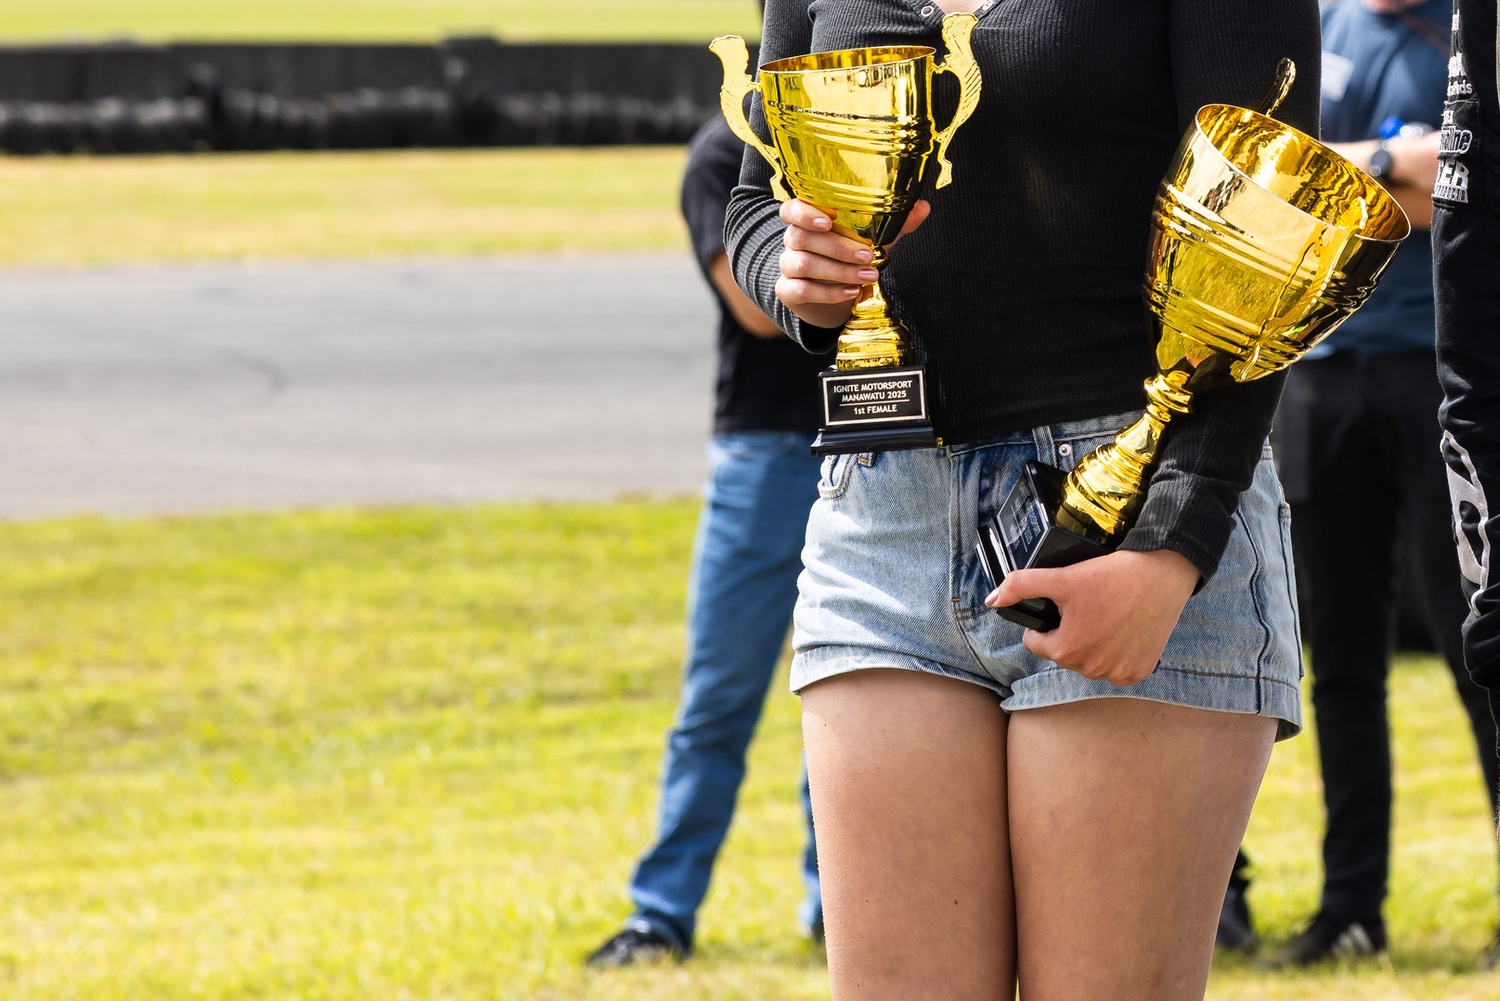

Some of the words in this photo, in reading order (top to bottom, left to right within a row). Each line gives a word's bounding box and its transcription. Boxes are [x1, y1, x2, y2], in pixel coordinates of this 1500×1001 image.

[833, 384, 860, 393] IGNITE
[860, 380, 913, 392] MOTORSPORT
[841, 392, 886, 402] MANAWATU
[887, 390, 907, 399] 2025
[853, 407, 866, 415] 1st
[867, 404, 898, 414] FEMALE
